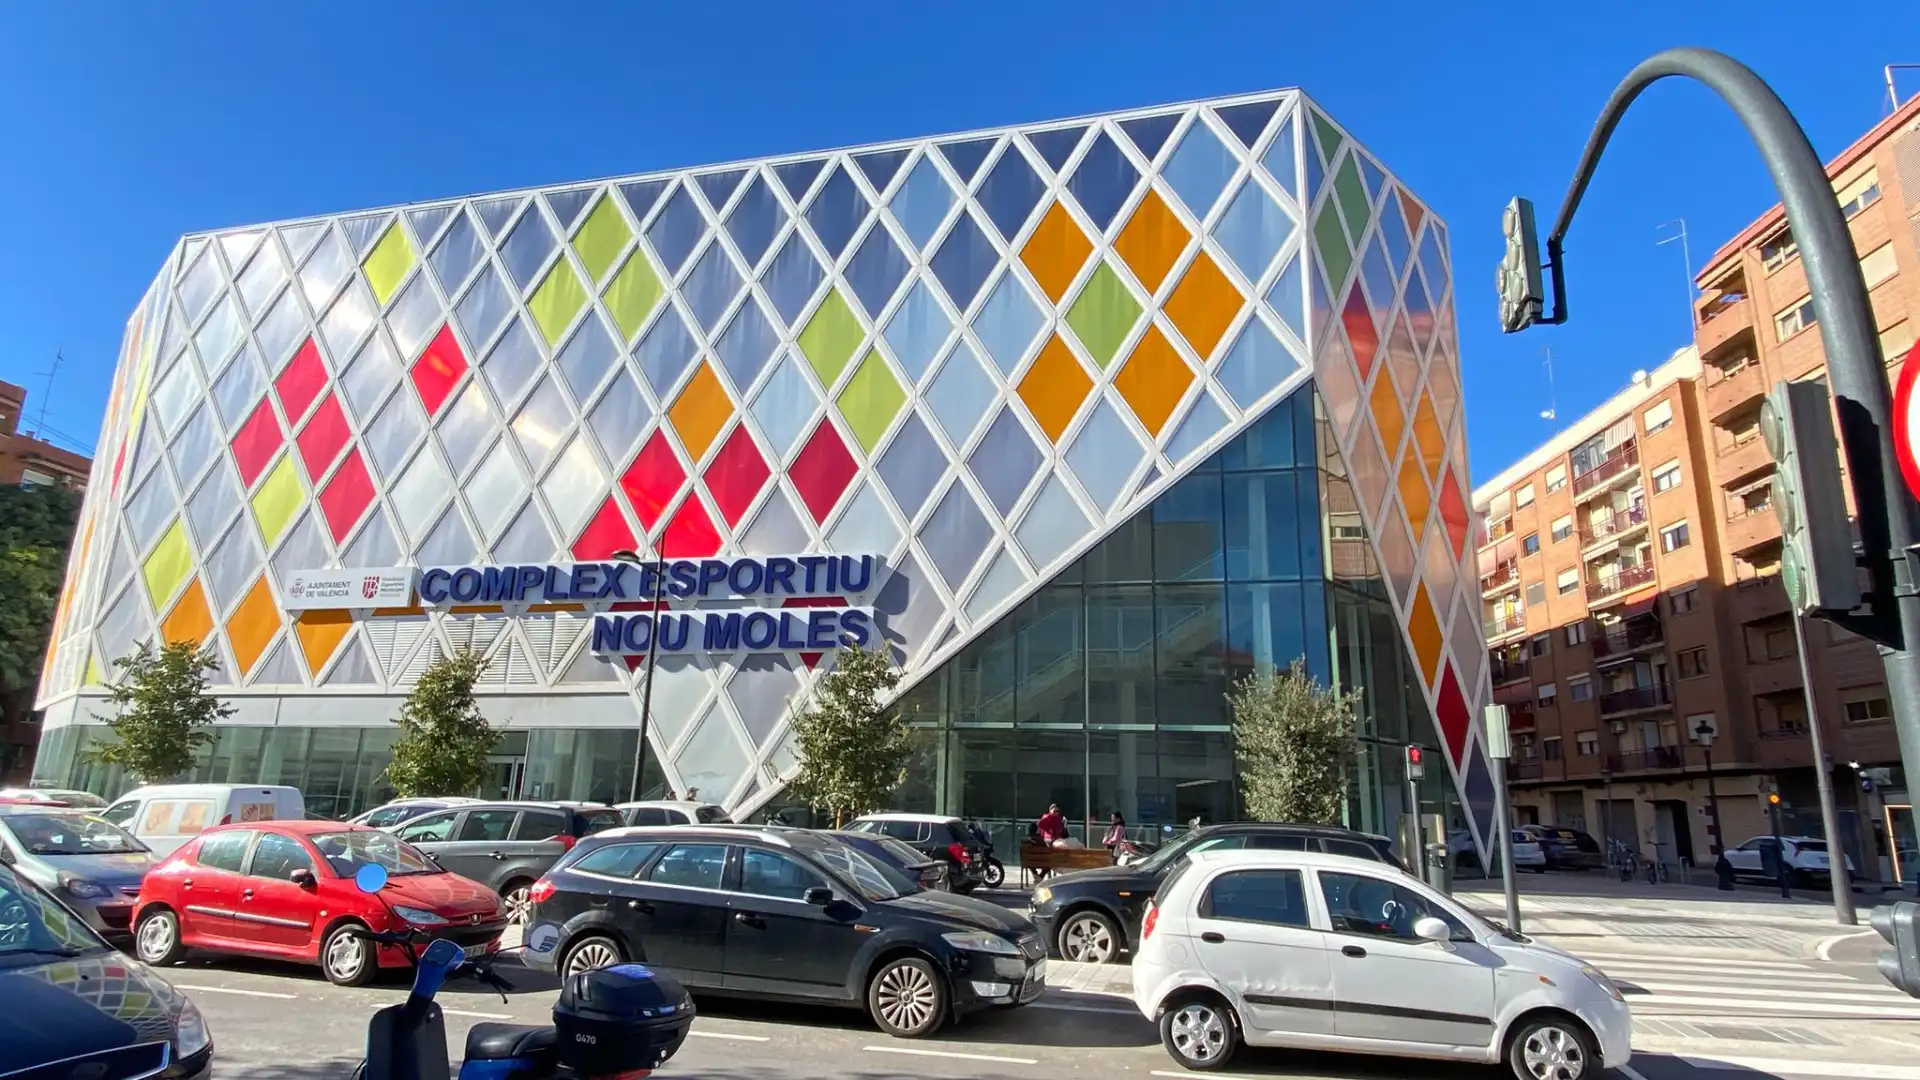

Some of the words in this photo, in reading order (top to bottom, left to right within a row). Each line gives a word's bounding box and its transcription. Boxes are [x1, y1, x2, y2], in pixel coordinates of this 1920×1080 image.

[420, 563, 628, 603] COMPLEX
[639, 554, 871, 597] ESPORTIU
[307, 581, 351, 589] AJUNTAMENT
[306, 590, 315, 598] DE
[592, 613, 689, 651] NOU
[703, 609, 869, 650] MOLES
[576, 1033, 597, 1045] 0470
